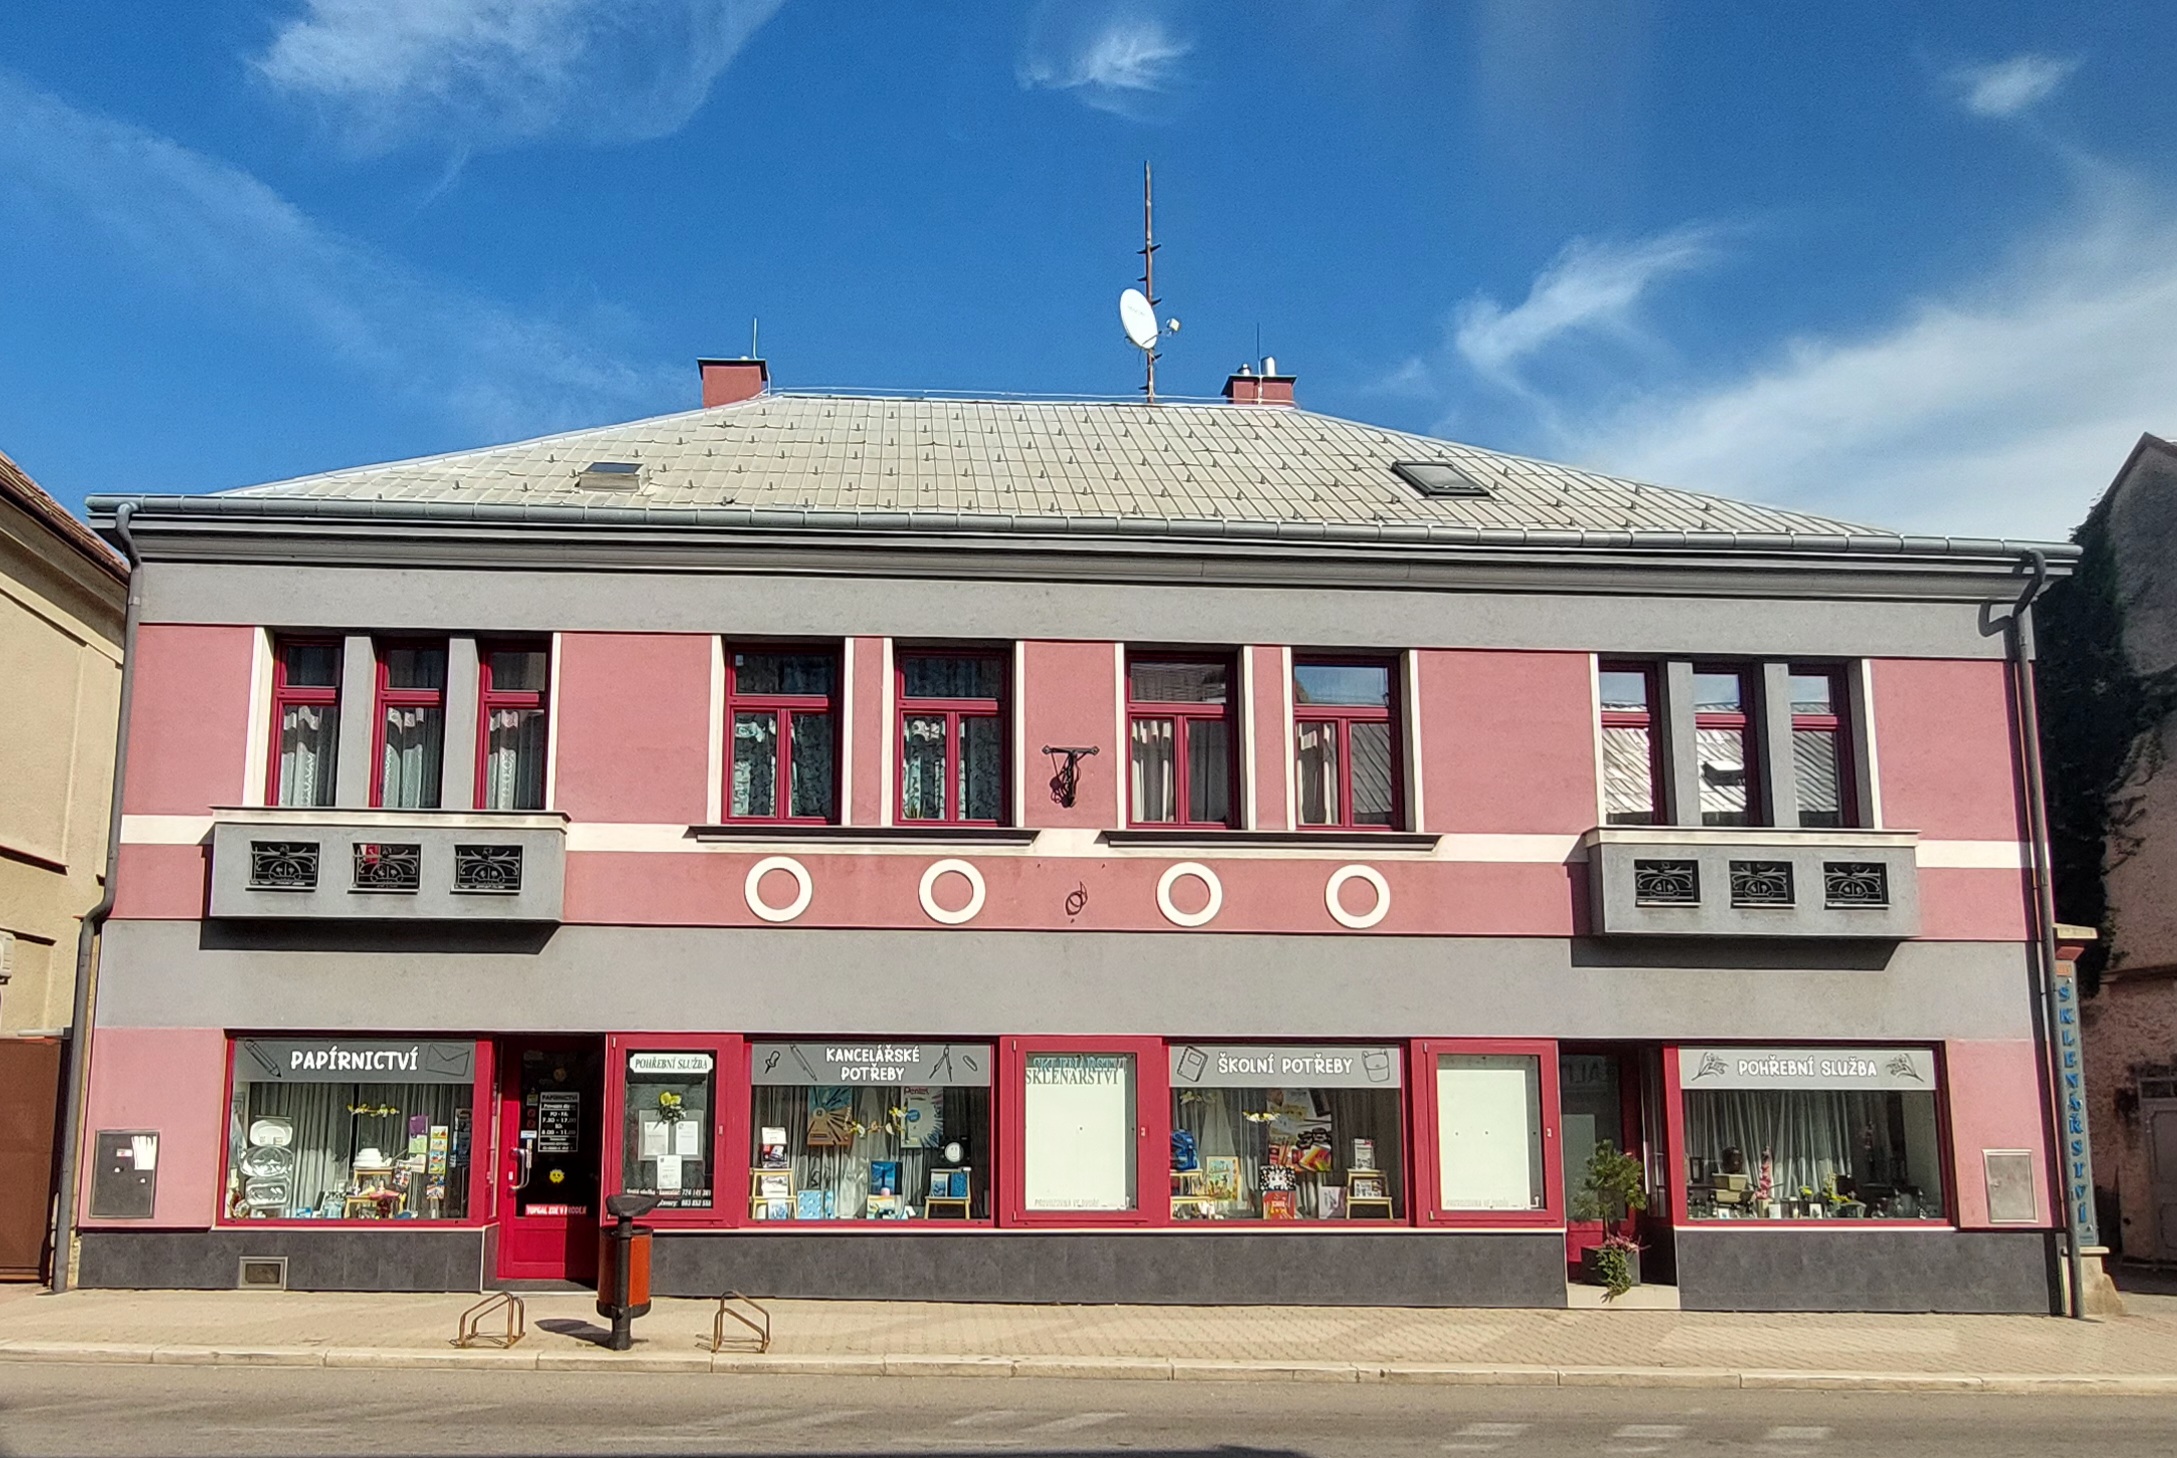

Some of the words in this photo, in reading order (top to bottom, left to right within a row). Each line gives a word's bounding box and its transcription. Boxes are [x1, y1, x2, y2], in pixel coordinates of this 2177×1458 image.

[291, 1046, 419, 1070] PAPÍRNICTVÍ
[634, 1056, 676, 1069] POHŘEBNÍ
[677, 1057, 708, 1070] SLUŽBA
[825, 1044, 920, 1063] KANCELÁŘSKÉ
[1217, 1052, 1275, 1074] ŠKOLNÍ
[1281, 1053, 1353, 1075] POTŘEBY
[840, 1064, 905, 1082] POTŘEBY
[1737, 1055, 1815, 1077] POHŘEBNÍ
[1821, 1057, 1877, 1077] SLUŽBA
[2058, 985, 2087, 1224] SKLENÁŘSTVÍ
